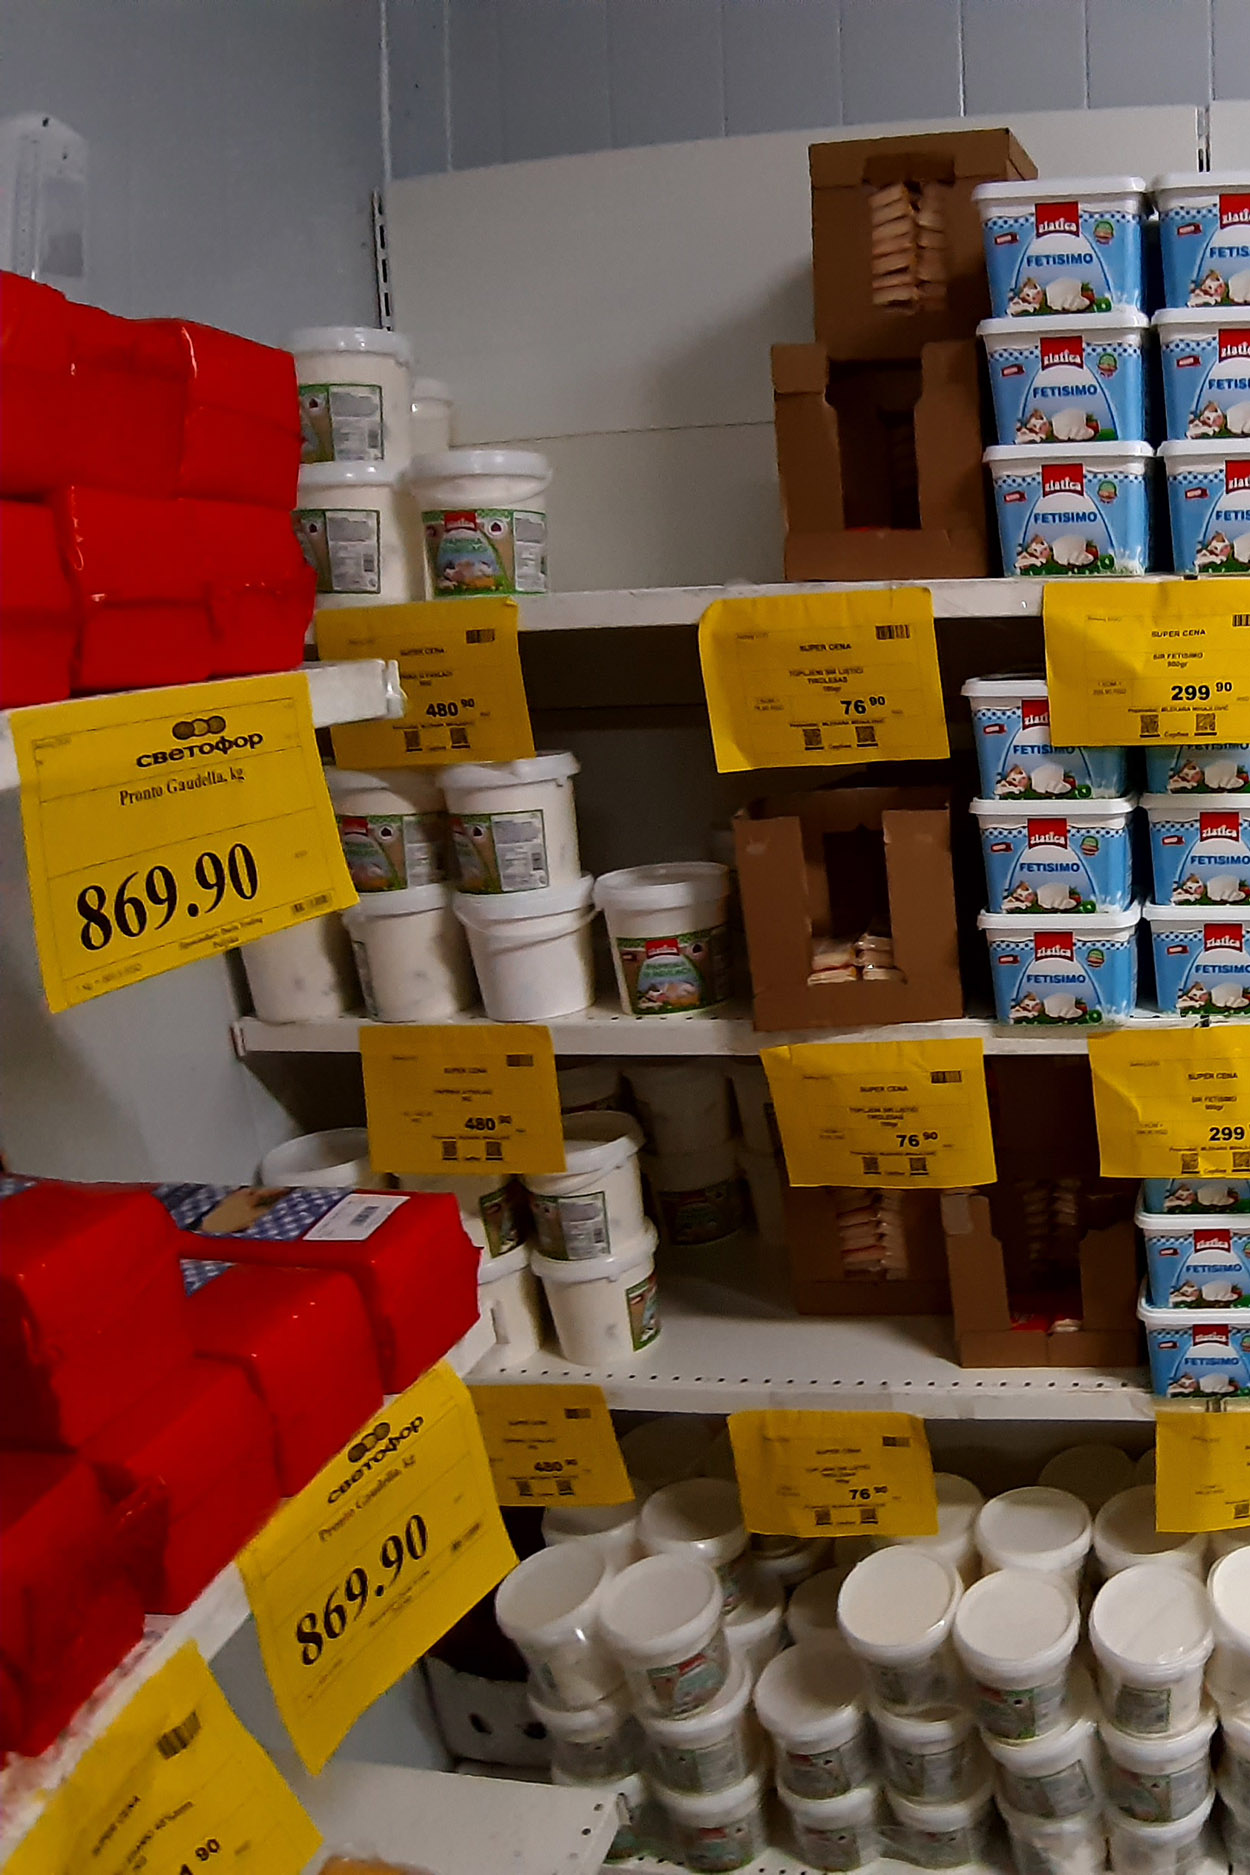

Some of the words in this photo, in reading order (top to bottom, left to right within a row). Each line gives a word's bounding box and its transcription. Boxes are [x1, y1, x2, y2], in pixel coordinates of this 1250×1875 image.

[1038, 217, 1077, 233] zlatica
[1027, 253, 1093, 267] FETISIMO
[1043, 348, 1081, 365] zlatica
[1033, 384, 1097, 398] FETISIMO
[1045, 477, 1081, 492] zlatica
[1034, 512, 1097, 524] FETISIMO
[1151, 630, 1180, 638] SUPER
[1171, 685, 1211, 701] 299
[1215, 682, 1232, 692] 90
[426, 702, 458, 718] 480
[840, 700, 866, 715] 76
[869, 696, 885, 706] 90
[1024, 712, 1048, 725] zlati
[119, 784, 164, 806] Pronto
[229, 766, 245, 782] kg
[1030, 831, 1065, 844] zlatica
[1202, 825, 1237, 838] zlatica
[1190, 855, 1250, 866] FETISIMO
[1019, 862, 1080, 873] FETISIMO
[76, 842, 259, 951] 869.90
[1206, 937, 1240, 950] zlatica
[1036, 945, 1071, 958] zlatica
[1026, 974, 1086, 984] FETISIMO
[465, 1117, 496, 1130] 480
[896, 1134, 920, 1147] 76
[1209, 1126, 1245, 1142] 299
[1186, 1264, 1242, 1274] FETISIMO
[1184, 1357, 1239, 1367] FETISIMO
[849, 1488, 871, 1500] 76
[295, 1514, 428, 1666] 869.90
[195, 1838, 221, 1862] 90
